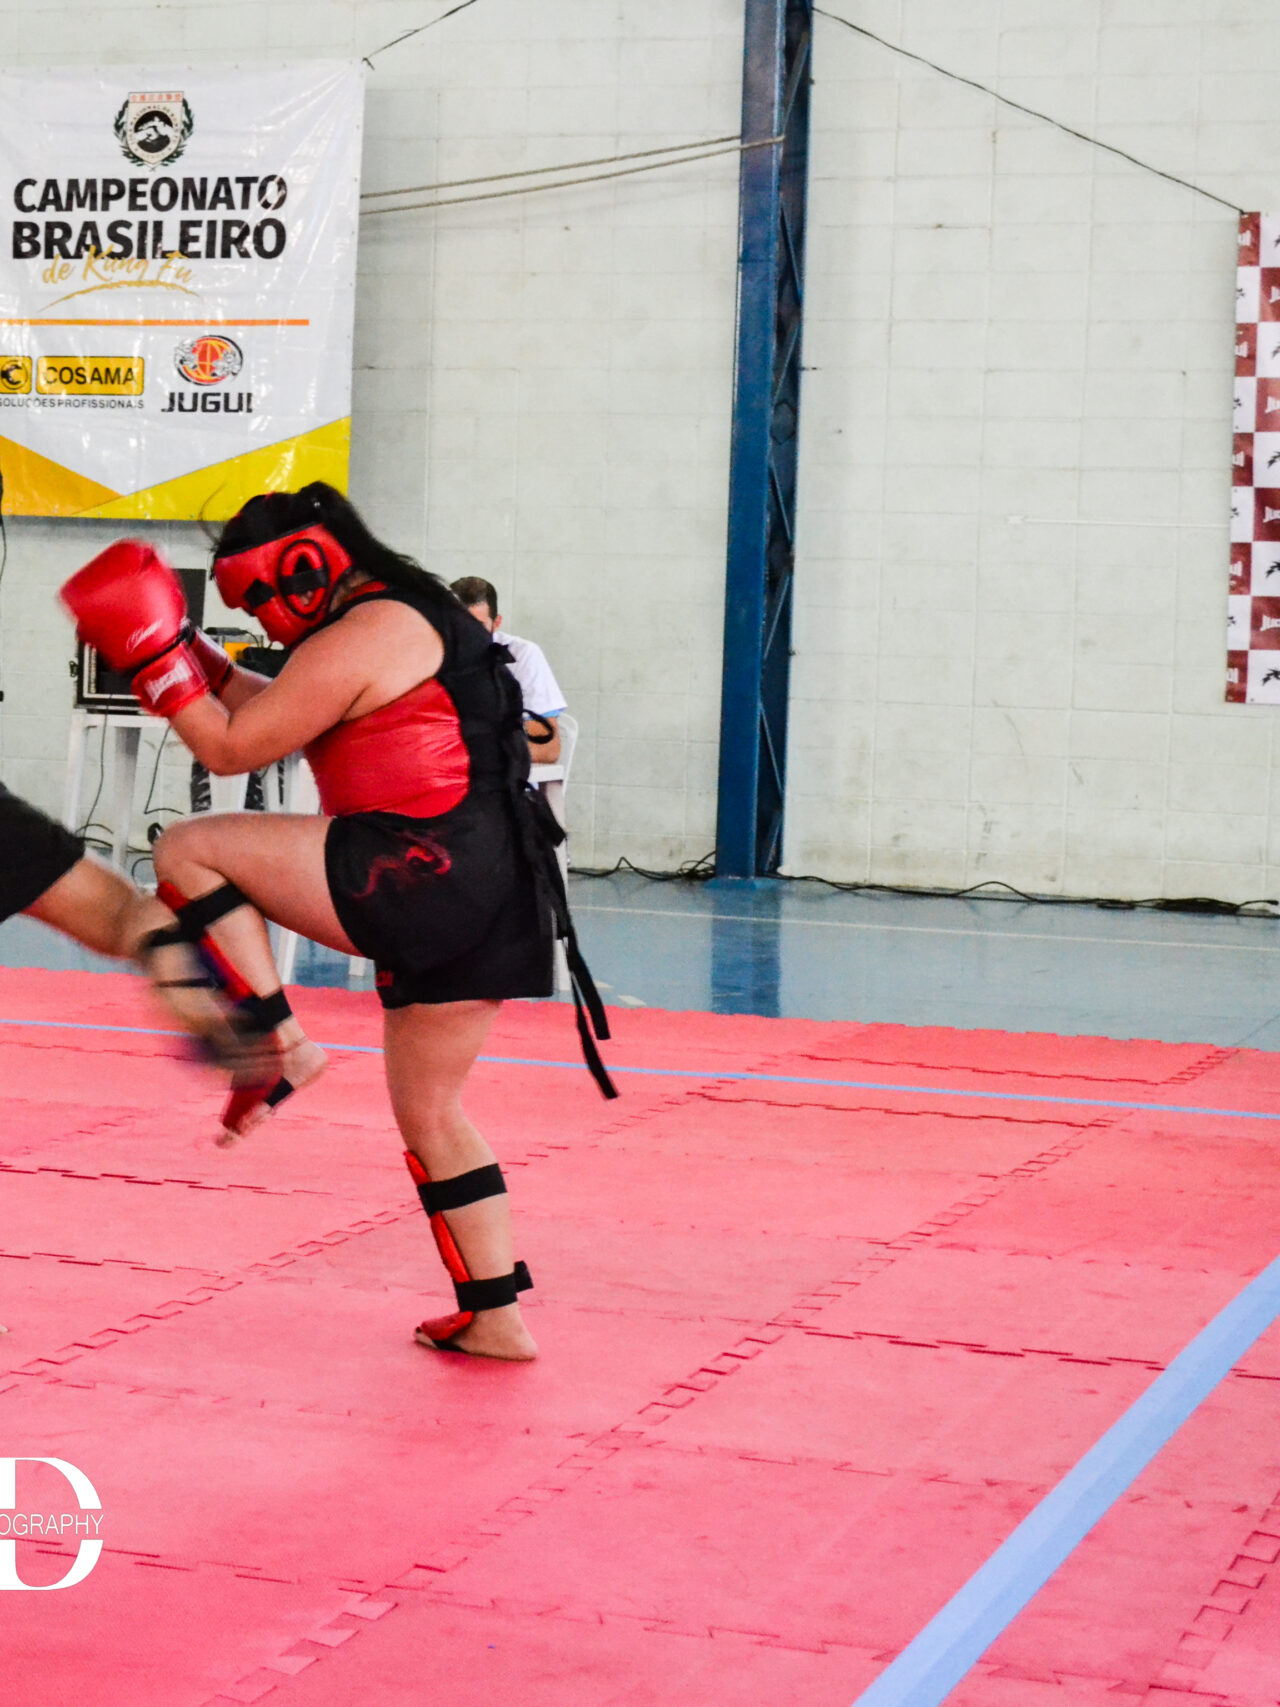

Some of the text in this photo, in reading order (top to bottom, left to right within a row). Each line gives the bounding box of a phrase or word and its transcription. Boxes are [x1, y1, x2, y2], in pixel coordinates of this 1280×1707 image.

[13, 174, 288, 213] CAMPEONATO
[12, 217, 287, 260] BRASILEIRO
[42, 244, 197, 284] de Kung Fu
[44, 366, 138, 386] COSAMA
[57, 398, 144, 410] PROFISSIONAS
[161, 392, 253, 413] JUGUI
